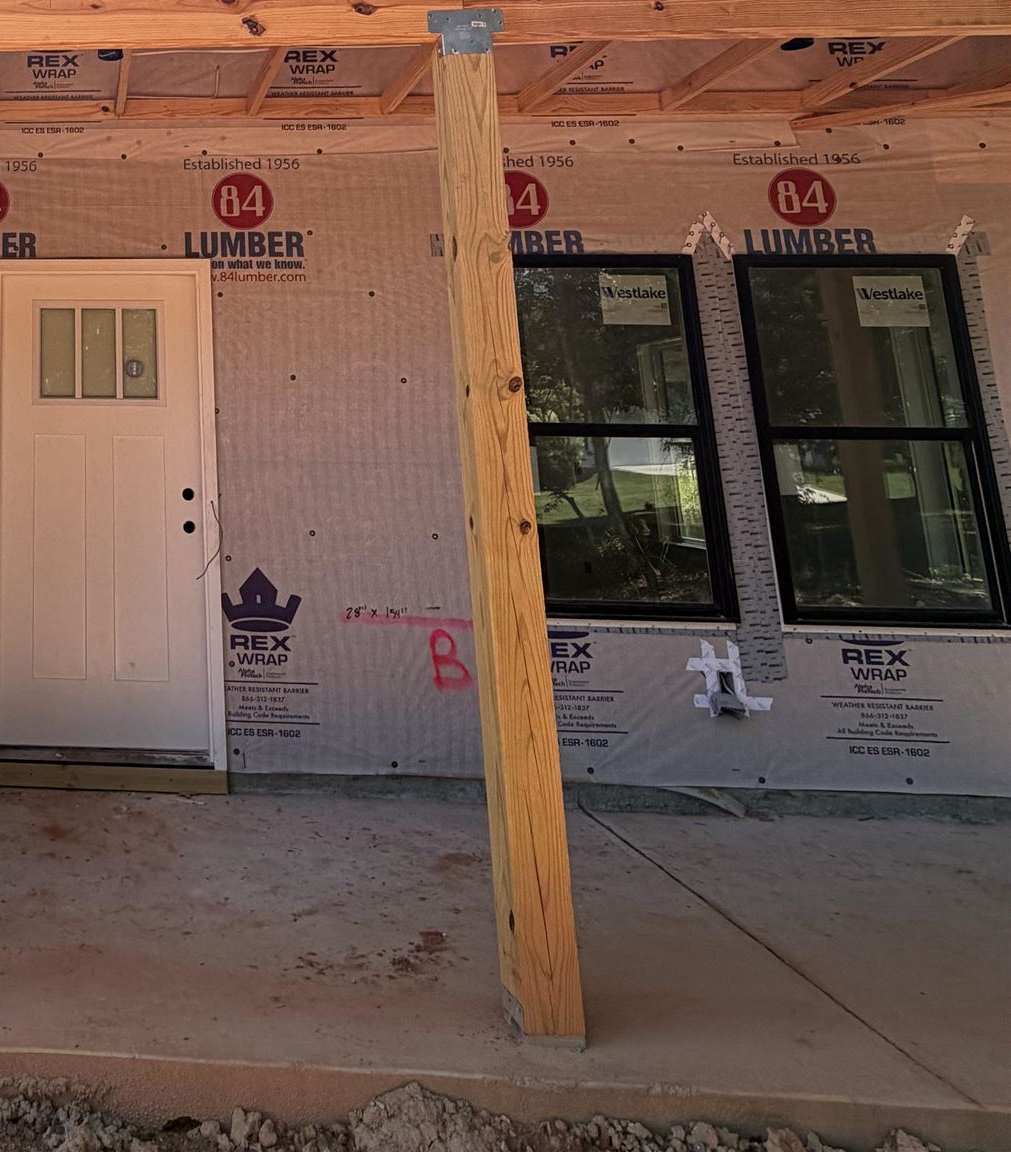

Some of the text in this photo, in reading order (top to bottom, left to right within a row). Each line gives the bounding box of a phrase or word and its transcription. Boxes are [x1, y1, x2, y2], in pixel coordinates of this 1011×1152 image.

[27, 55, 79, 67] REX
[32, 69, 76, 79] WRAP
[289, 64, 335, 74] WRAP
[183, 158, 300, 171] Established 1956
[540, 156, 574, 168] 1956
[733, 153, 861, 165] Established 1956
[5, 161, 37, 172] 1956
[220, 185, 265, 217] 84
[777, 180, 828, 214] 84
[185, 232, 305, 258] LUMBER
[510, 230, 585, 255] MBER
[743, 229, 876, 254] LUMBER
[211, 259, 305, 269] on what we know.
[602, 286, 666, 299] Westlake
[856, 287, 924, 300] Westlake
[230, 635, 291, 651] REX
[550, 642, 593, 659] EX
[237, 653, 288, 666] WRAP
[430, 629, 474, 692] B
[842, 648, 910, 667] REX
[551, 661, 591, 673] RAP
[850, 667, 907, 681] WRAP
[244, 728, 255, 736] ES
[849, 746, 865, 754] ICC
[868, 747, 879, 755] ES
